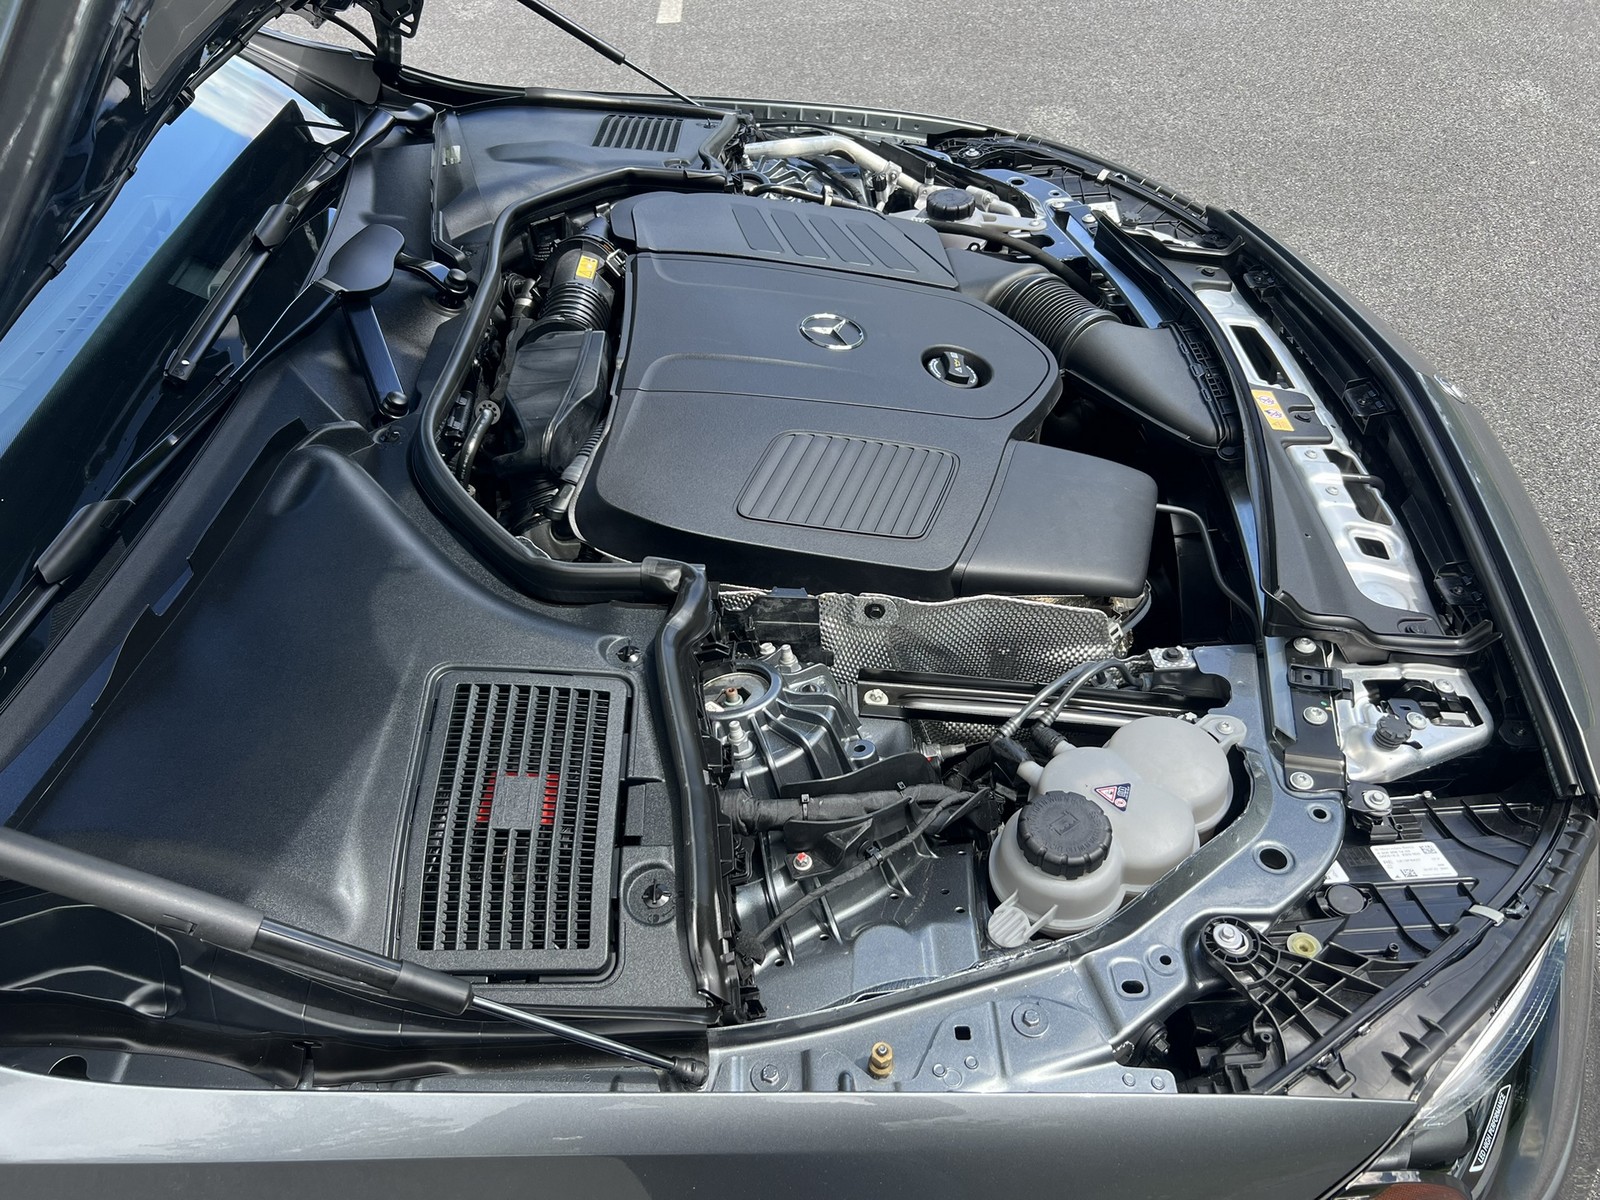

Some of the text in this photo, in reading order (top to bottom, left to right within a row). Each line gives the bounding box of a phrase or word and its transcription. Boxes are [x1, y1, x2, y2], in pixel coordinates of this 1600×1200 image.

[1477, 1092, 1506, 1163] LED HIGH PERFORMANCE
